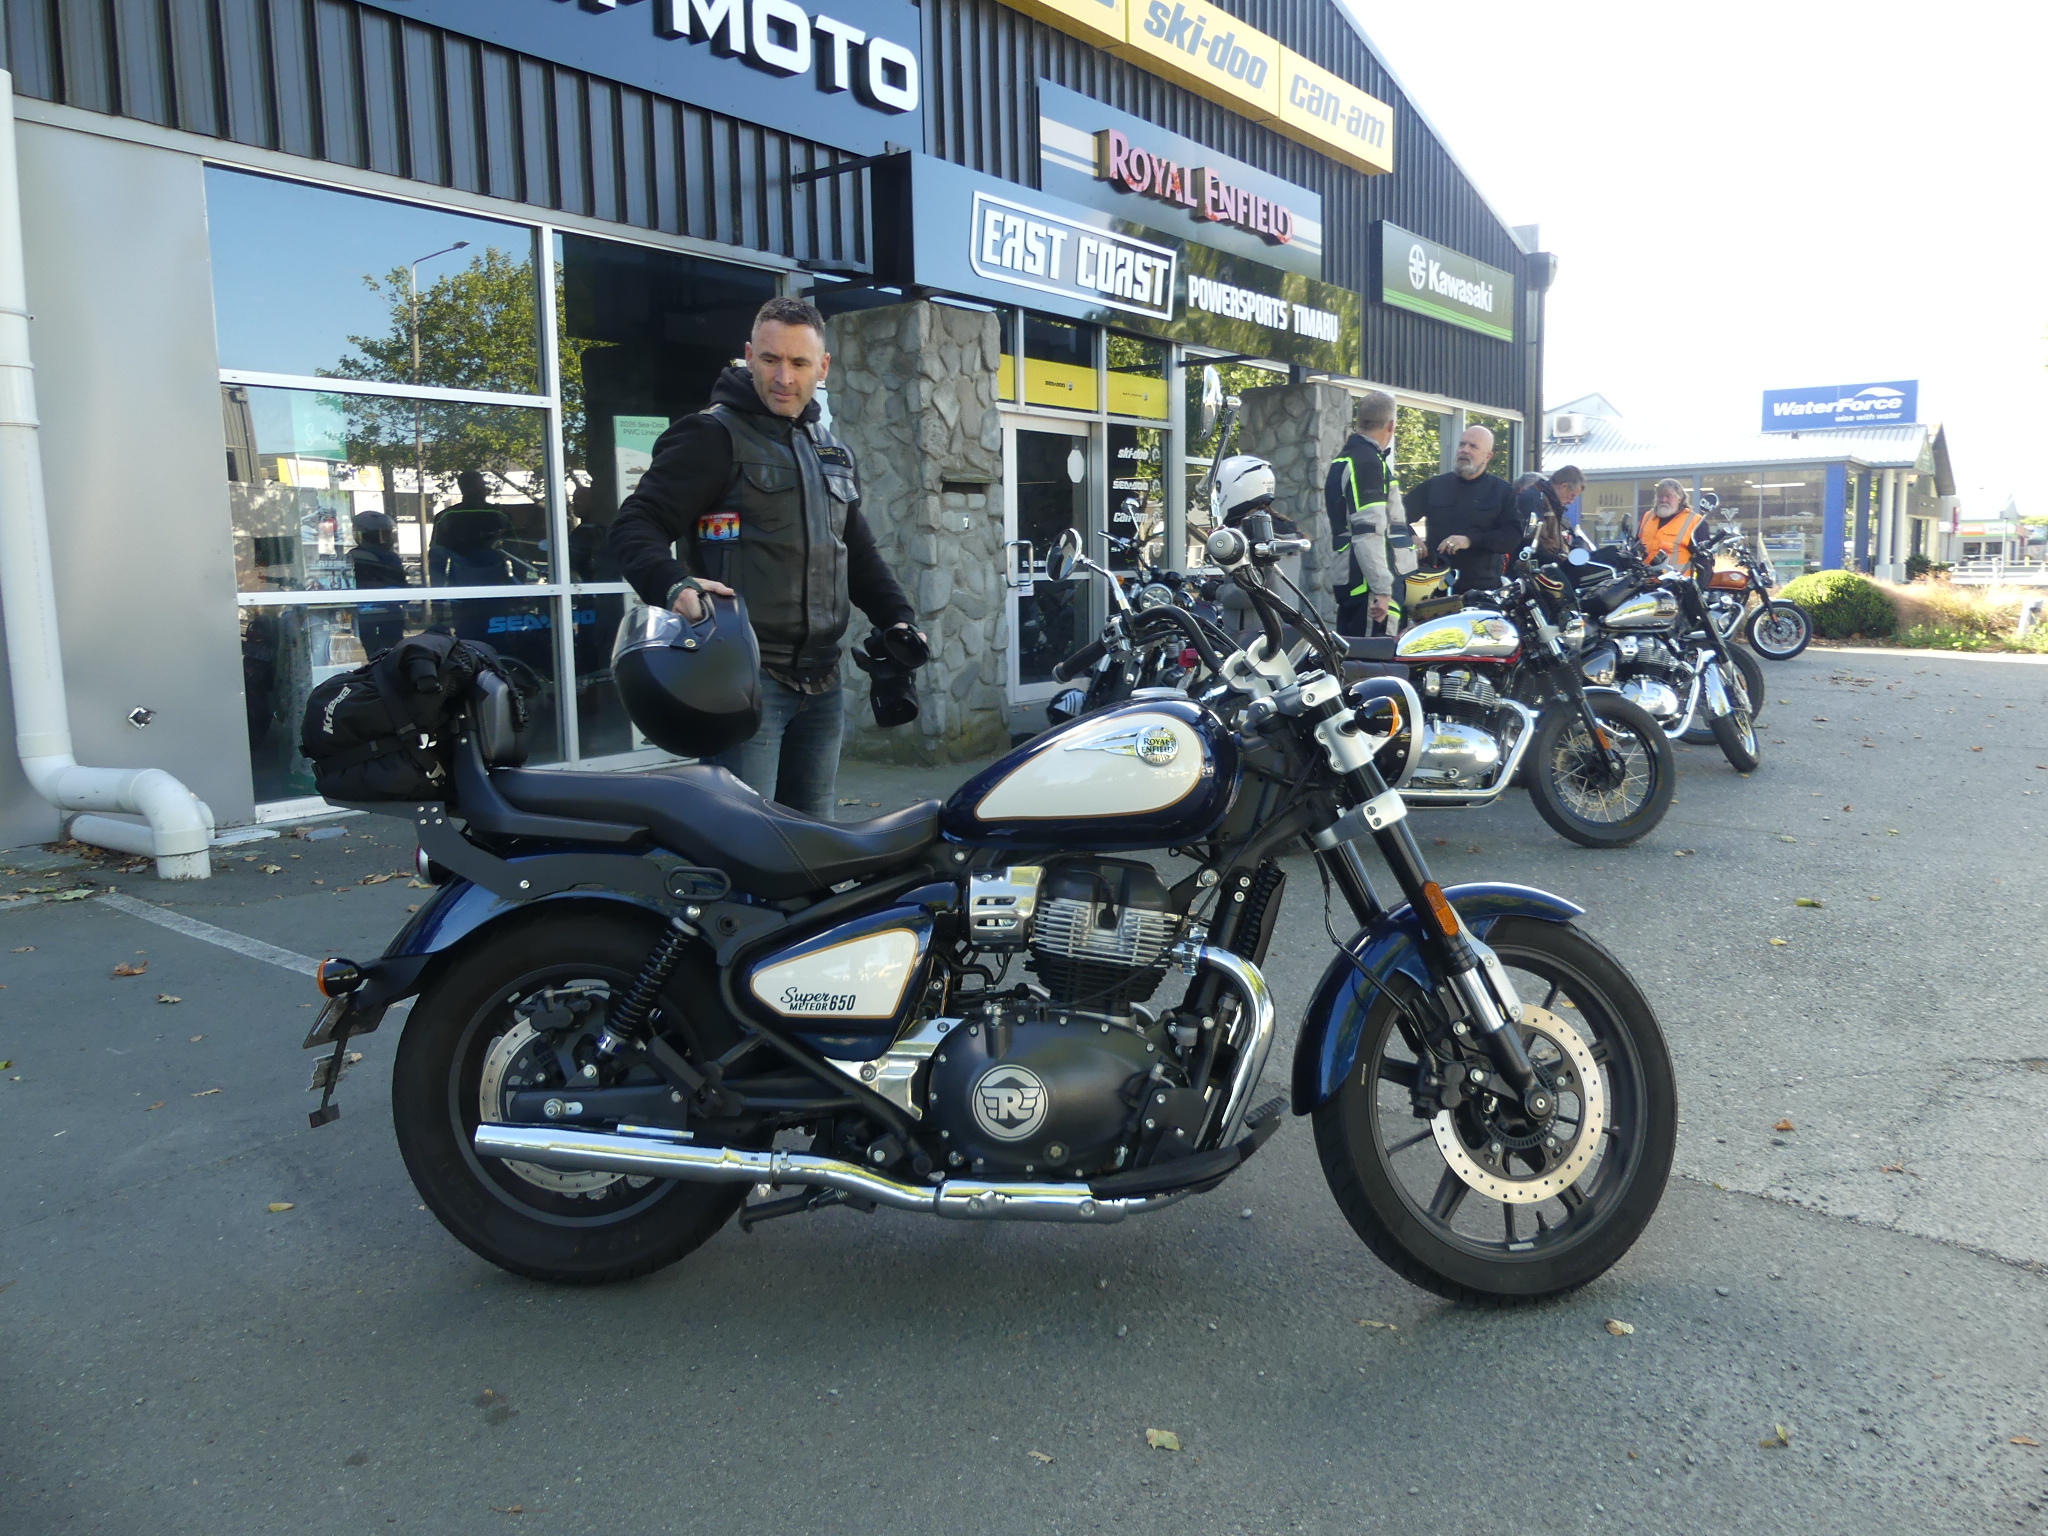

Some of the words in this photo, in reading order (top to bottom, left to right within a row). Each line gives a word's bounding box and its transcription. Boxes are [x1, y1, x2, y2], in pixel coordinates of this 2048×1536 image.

[1143, 0, 1268, 90] ski-doo
[1289, 73, 1386, 149] can-am
[1108, 129, 1198, 209] ROYAL
[1203, 166, 1293, 245] ENFIELD
[982, 208, 1068, 280] EAST
[1076, 236, 1169, 306] COAST
[1428, 259, 1493, 313] Kawasaki
[1187, 274, 1288, 331] POWERSPORTS
[1292, 303, 1339, 343] TIMARU
[1773, 397, 1903, 416] WaterForce
[1876, 412, 1902, 420] water
[620, 420, 637, 428] 2026
[638, 421, 666, 429] Sea-Doo
[1117, 447, 1149, 460] ski-doo
[963, 517, 970, 528] 7
[322, 686, 352, 735] Kriega
[1141, 745, 1174, 754] ENFIELD
[1143, 737, 1170, 746] ROYAL
[780, 986, 831, 1008] Super
[789, 1001, 829, 1011] METEOR
[829, 994, 857, 1011] 650
